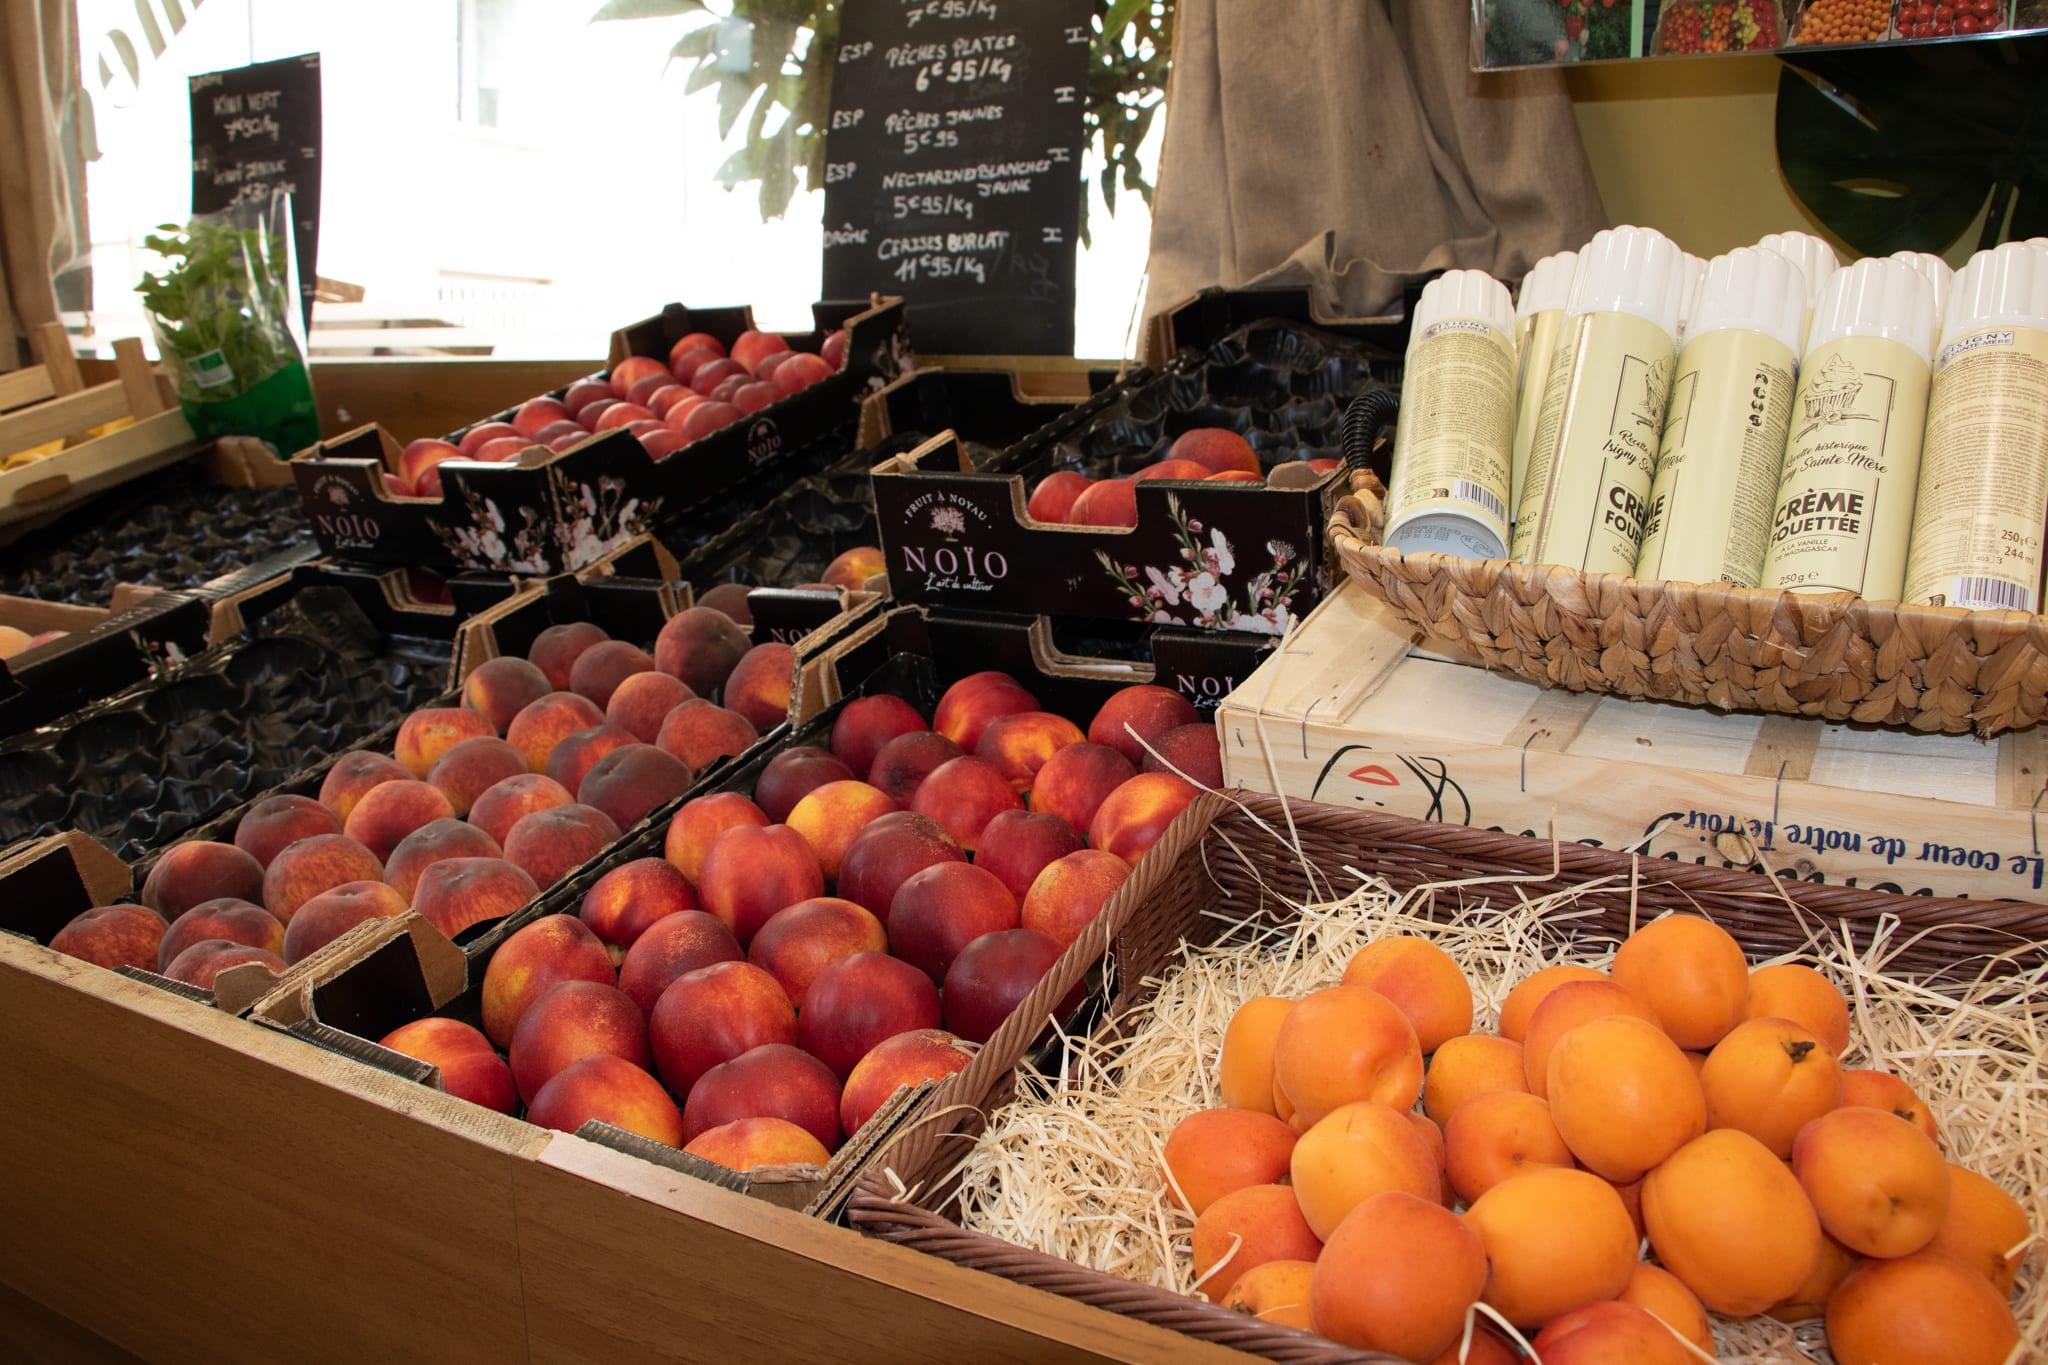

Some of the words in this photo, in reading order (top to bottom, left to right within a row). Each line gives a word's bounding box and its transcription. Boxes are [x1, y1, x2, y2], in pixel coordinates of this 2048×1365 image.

[838, 41, 873, 63] ESP
[951, 34, 1016, 57] PLATES
[832, 108, 865, 129] ESP
[945, 105, 1004, 126] JAUNES
[825, 162, 857, 183] ESP
[947, 231, 1011, 251] BURLAT
[1950, 331, 2011, 352] ISIGNY
[1603, 439, 1637, 466] Isigny
[1815, 440, 1870, 454] historique
[905, 493, 933, 518] FRUIT
[949, 493, 988, 521] NOYAU
[1774, 488, 1864, 527] CRÈME
[1771, 514, 1860, 548] FOUETTÉE
[1784, 545, 1839, 558] MADAGASCAR
[1798, 538, 1829, 547] VANILLE
[2004, 546, 2024, 560] 244
[1784, 824, 1861, 855] notre
[1867, 836, 1906, 865] de
[1915, 842, 2000, 871] coeur
[2007, 855, 2044, 889] Le
